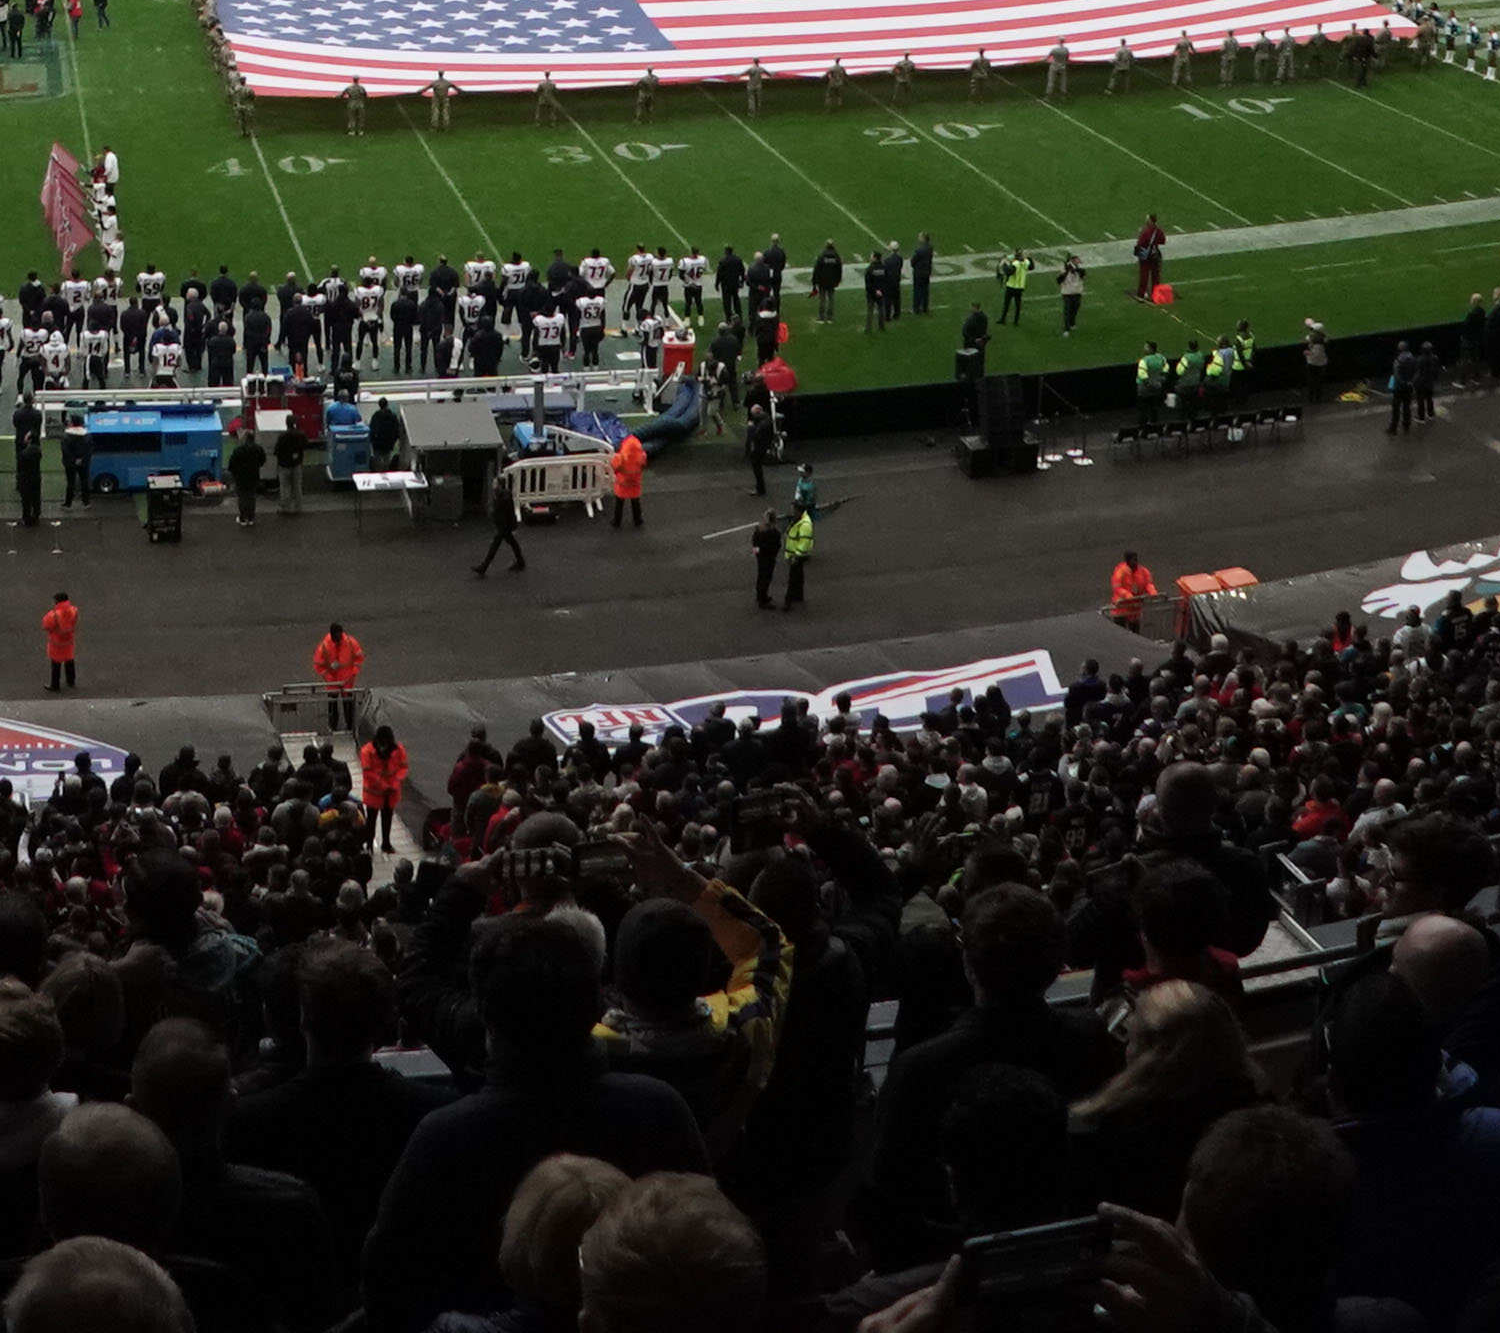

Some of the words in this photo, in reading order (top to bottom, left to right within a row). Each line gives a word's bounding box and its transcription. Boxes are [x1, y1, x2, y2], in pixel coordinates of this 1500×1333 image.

[589, 266, 605, 279] 77
[362, 296, 377, 309] 87
[468, 306, 479, 318] 16
[584, 306, 599, 319] 63
[542, 326, 559, 339] 73
[163, 354, 176, 367] 12
[558, 709, 669, 729] NFL
